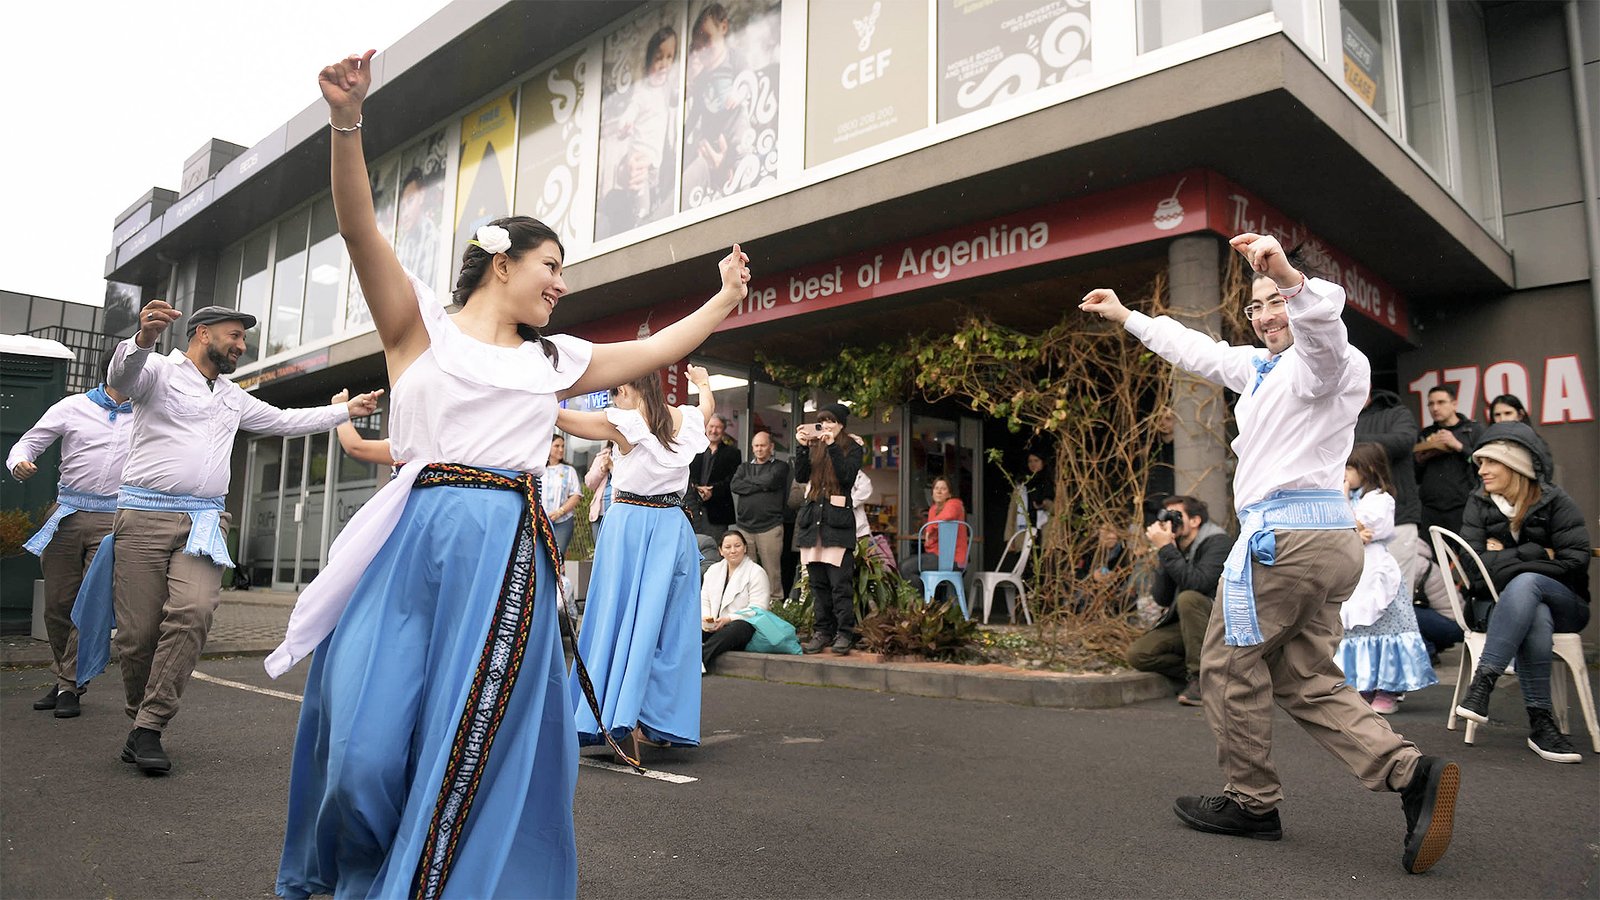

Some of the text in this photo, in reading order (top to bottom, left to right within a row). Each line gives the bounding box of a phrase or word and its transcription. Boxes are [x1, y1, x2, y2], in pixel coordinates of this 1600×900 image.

[841, 48, 892, 90] CEF
[735, 221, 1048, 315] The best of Argentina
[1344, 264, 1381, 318] store
